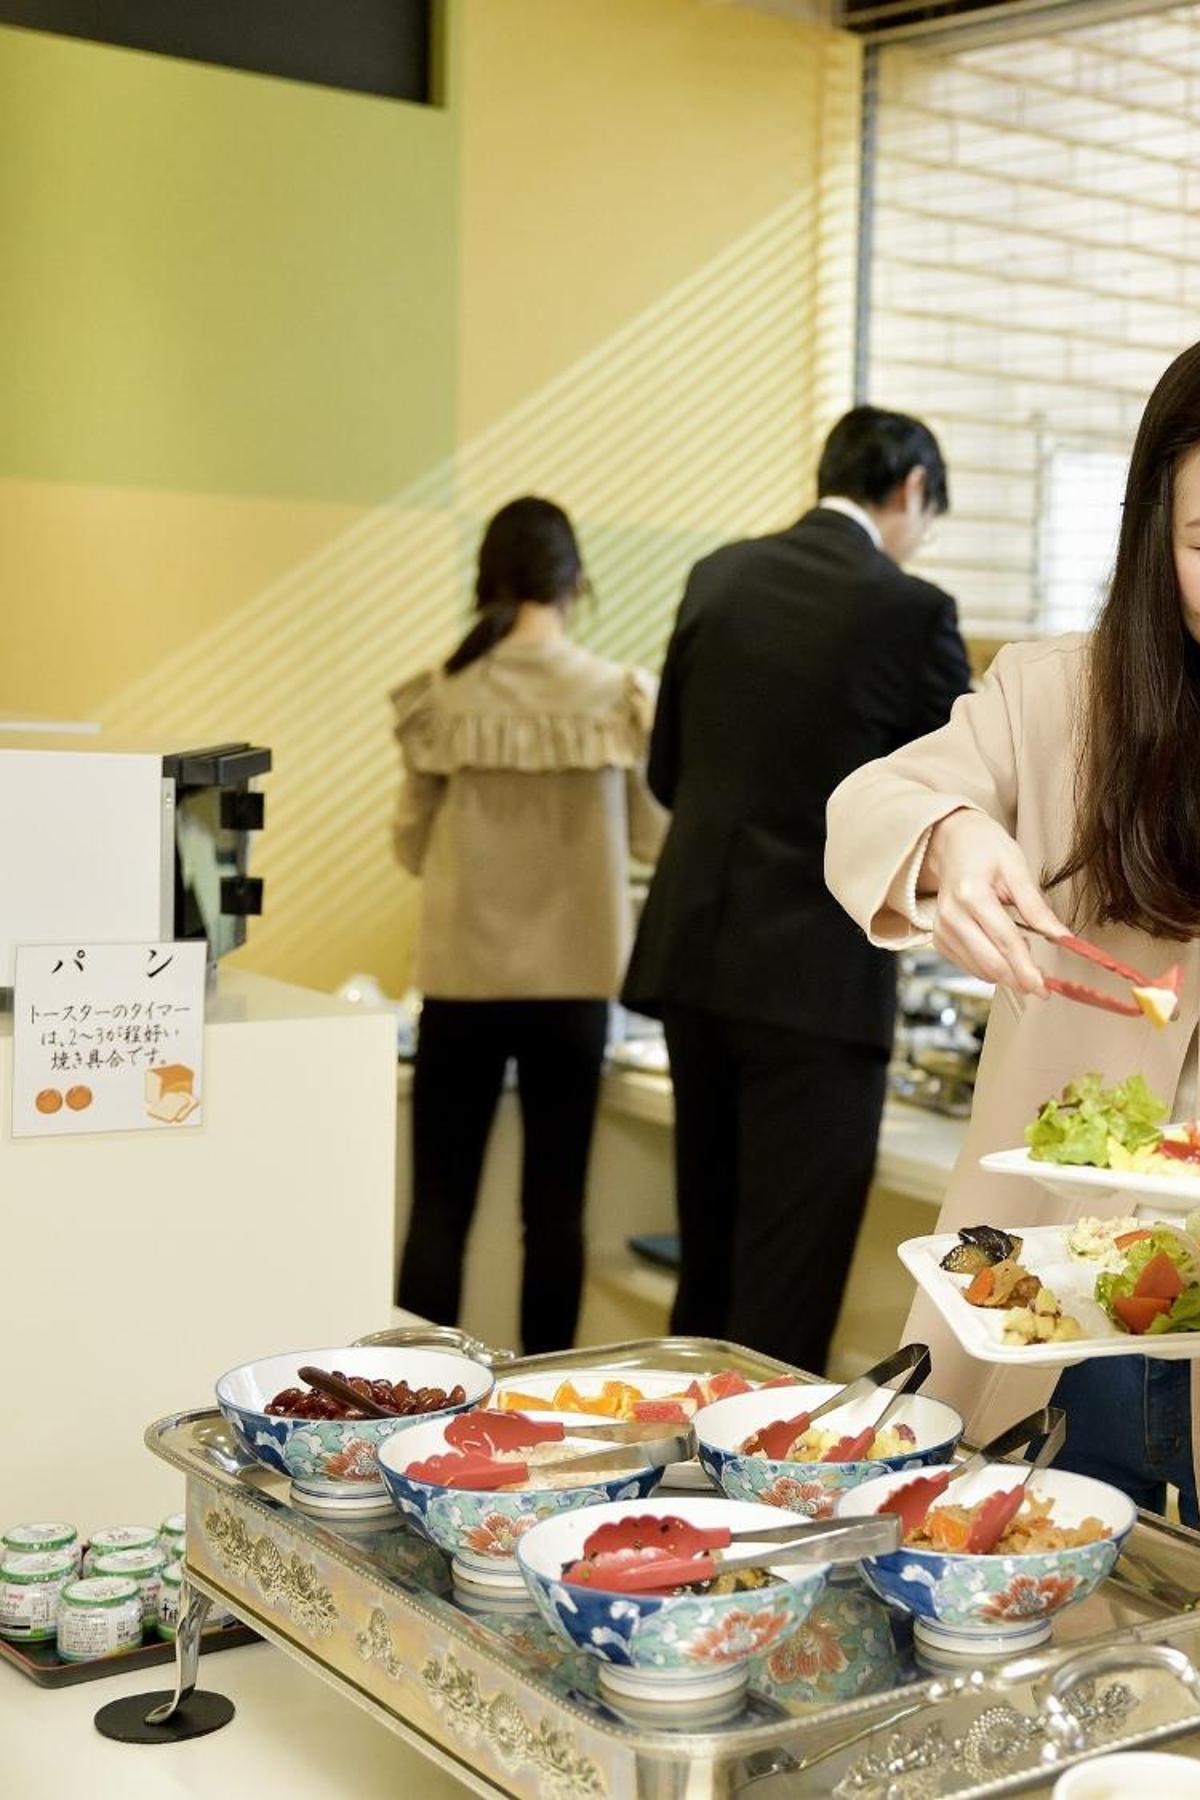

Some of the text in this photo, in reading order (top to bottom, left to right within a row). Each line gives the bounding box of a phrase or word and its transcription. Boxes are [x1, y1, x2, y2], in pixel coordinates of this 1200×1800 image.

[31, 1001, 190, 1025] トースターのタイマー
[50, 1046, 168, 1071] 焼き具合です。
